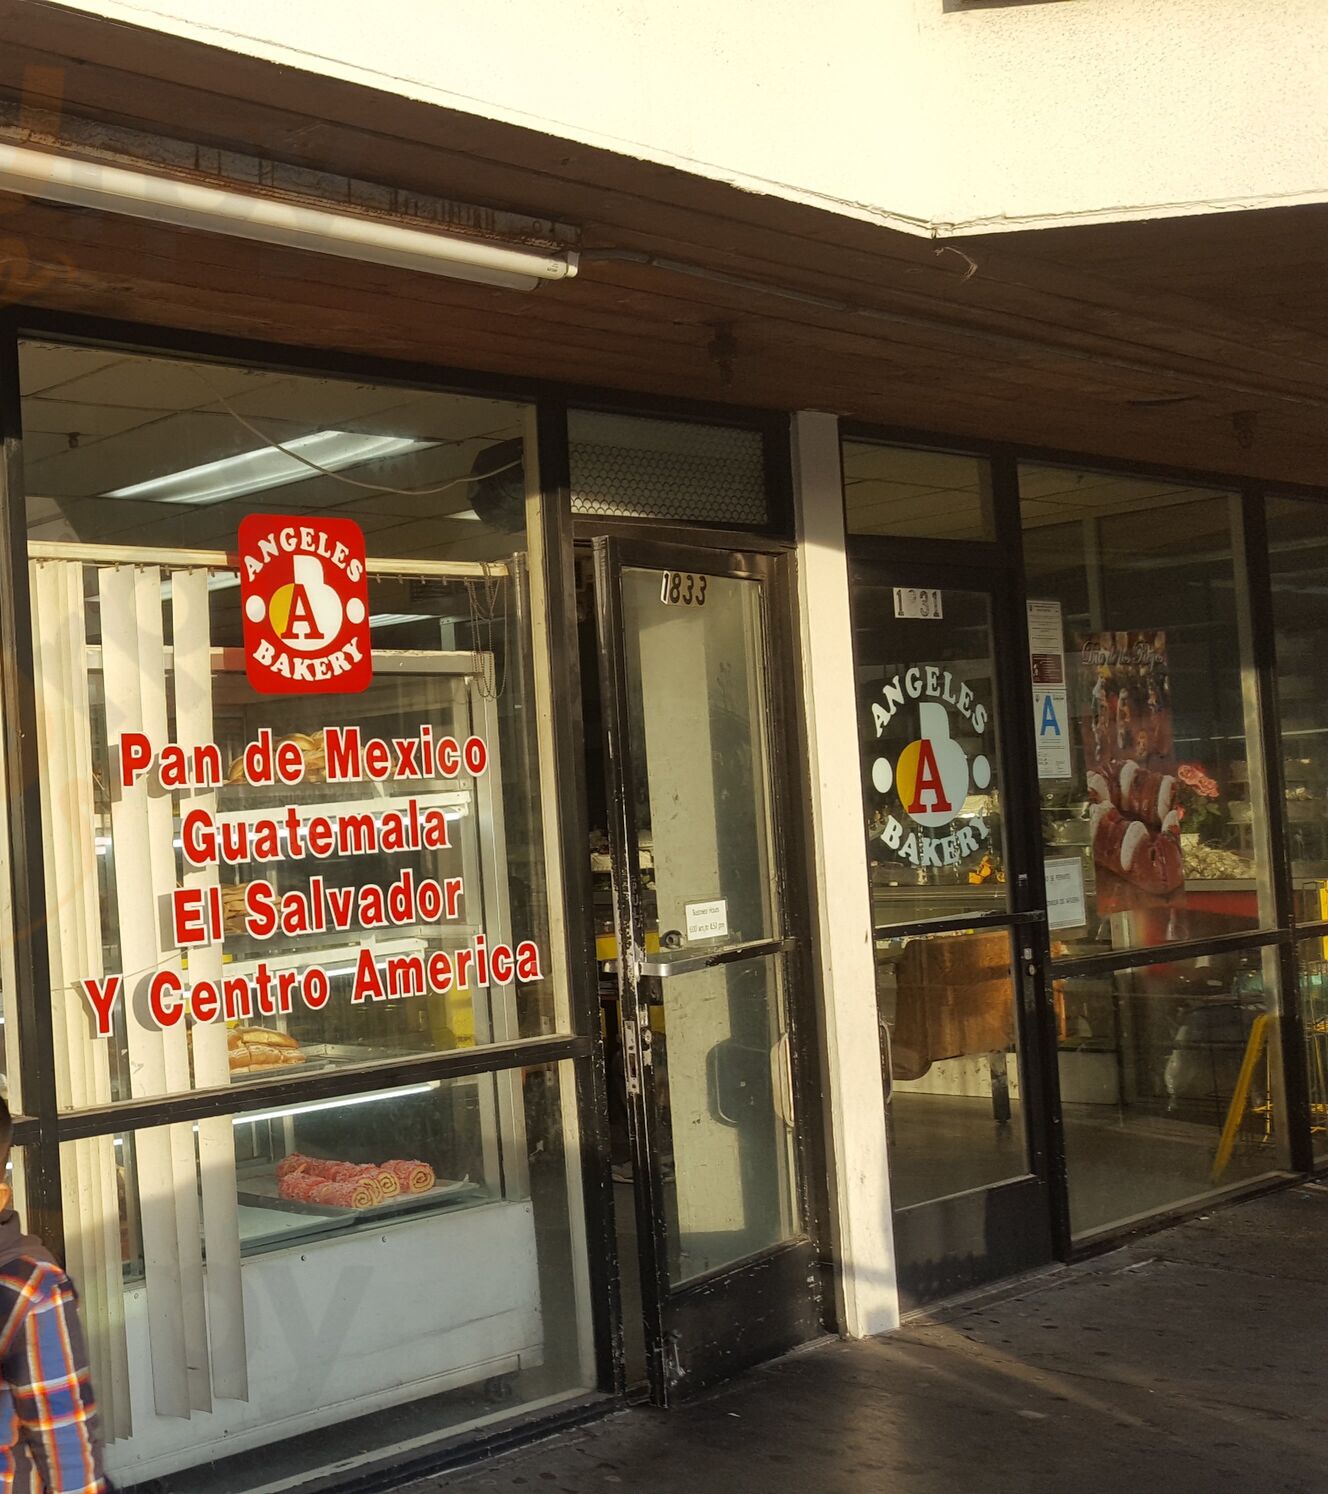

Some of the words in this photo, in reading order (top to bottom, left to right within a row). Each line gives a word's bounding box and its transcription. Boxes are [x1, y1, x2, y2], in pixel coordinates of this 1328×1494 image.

[244, 527, 363, 582] ANGELES
[281, 584, 324, 639] A
[663, 573, 706, 605] 1833
[253, 637, 363, 681] BAKERY
[872, 666, 987, 738] ANGELES
[1040, 695, 1061, 736] A
[120, 732, 223, 790] Pan
[244, 727, 305, 787] de
[323, 724, 489, 781] Mexico
[908, 739, 952, 813] A
[181, 799, 452, 867] Guatemala
[881, 808, 990, 867] BAKERY
[173, 885, 224, 947] El
[245, 868, 464, 940] Salvador
[80, 975, 123, 1038] Y
[149, 965, 331, 1029] Centro
[351, 934, 544, 1005] America
